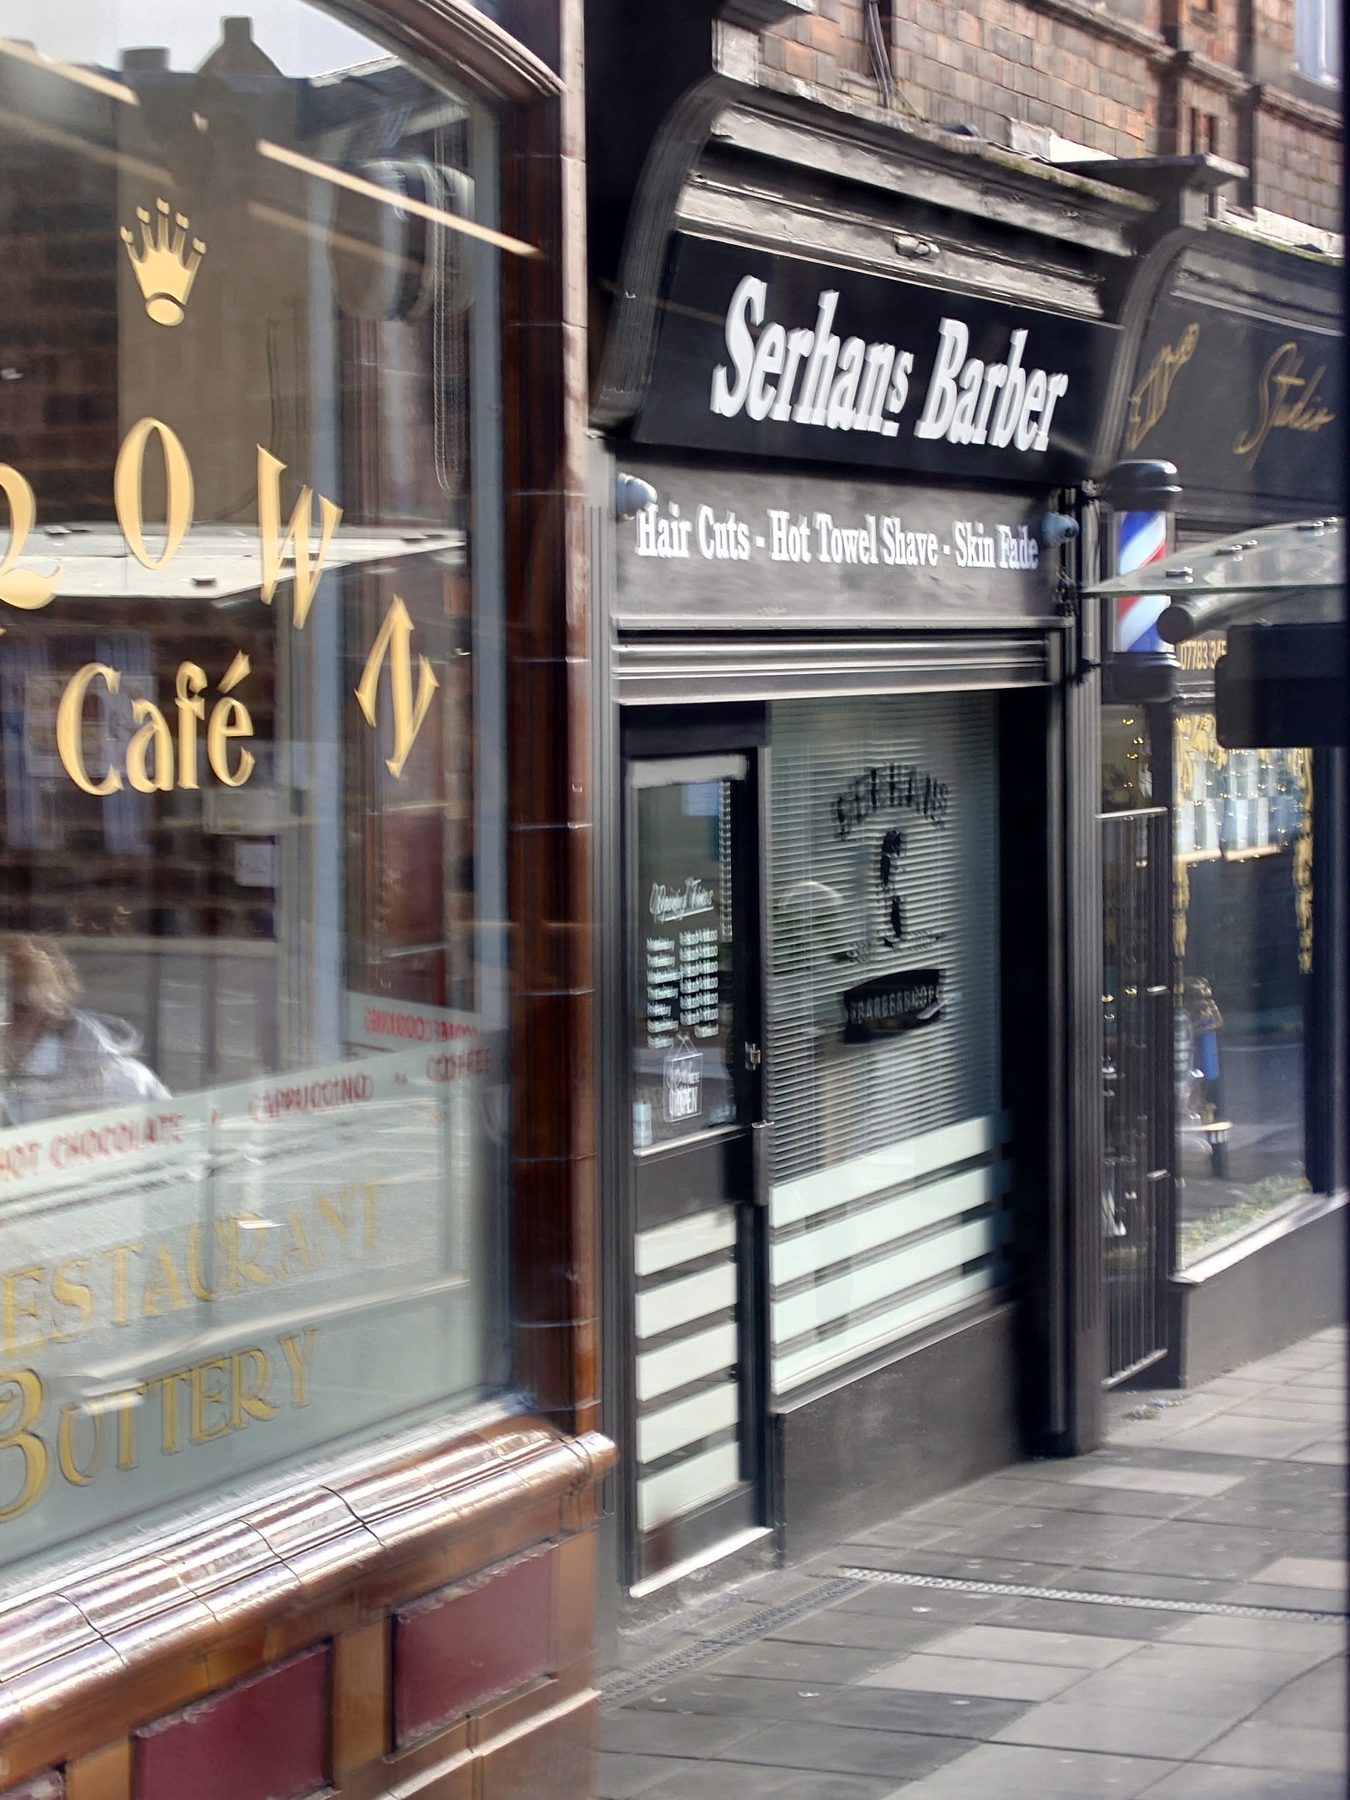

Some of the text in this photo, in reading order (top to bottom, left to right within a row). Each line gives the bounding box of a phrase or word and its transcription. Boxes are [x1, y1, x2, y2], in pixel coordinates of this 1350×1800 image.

[710, 274, 1069, 452] Serhans Barber
[635, 502, 692, 559] Hair
[697, 504, 751, 562] Cuts
[767, 506, 811, 564] Hot
[813, 510, 879, 567] Towel
[880, 513, 939, 568] Shave
[954, 520, 995, 569] Skin
[996, 525, 1039, 571] Fade
[56, 650, 255, 796] Café
